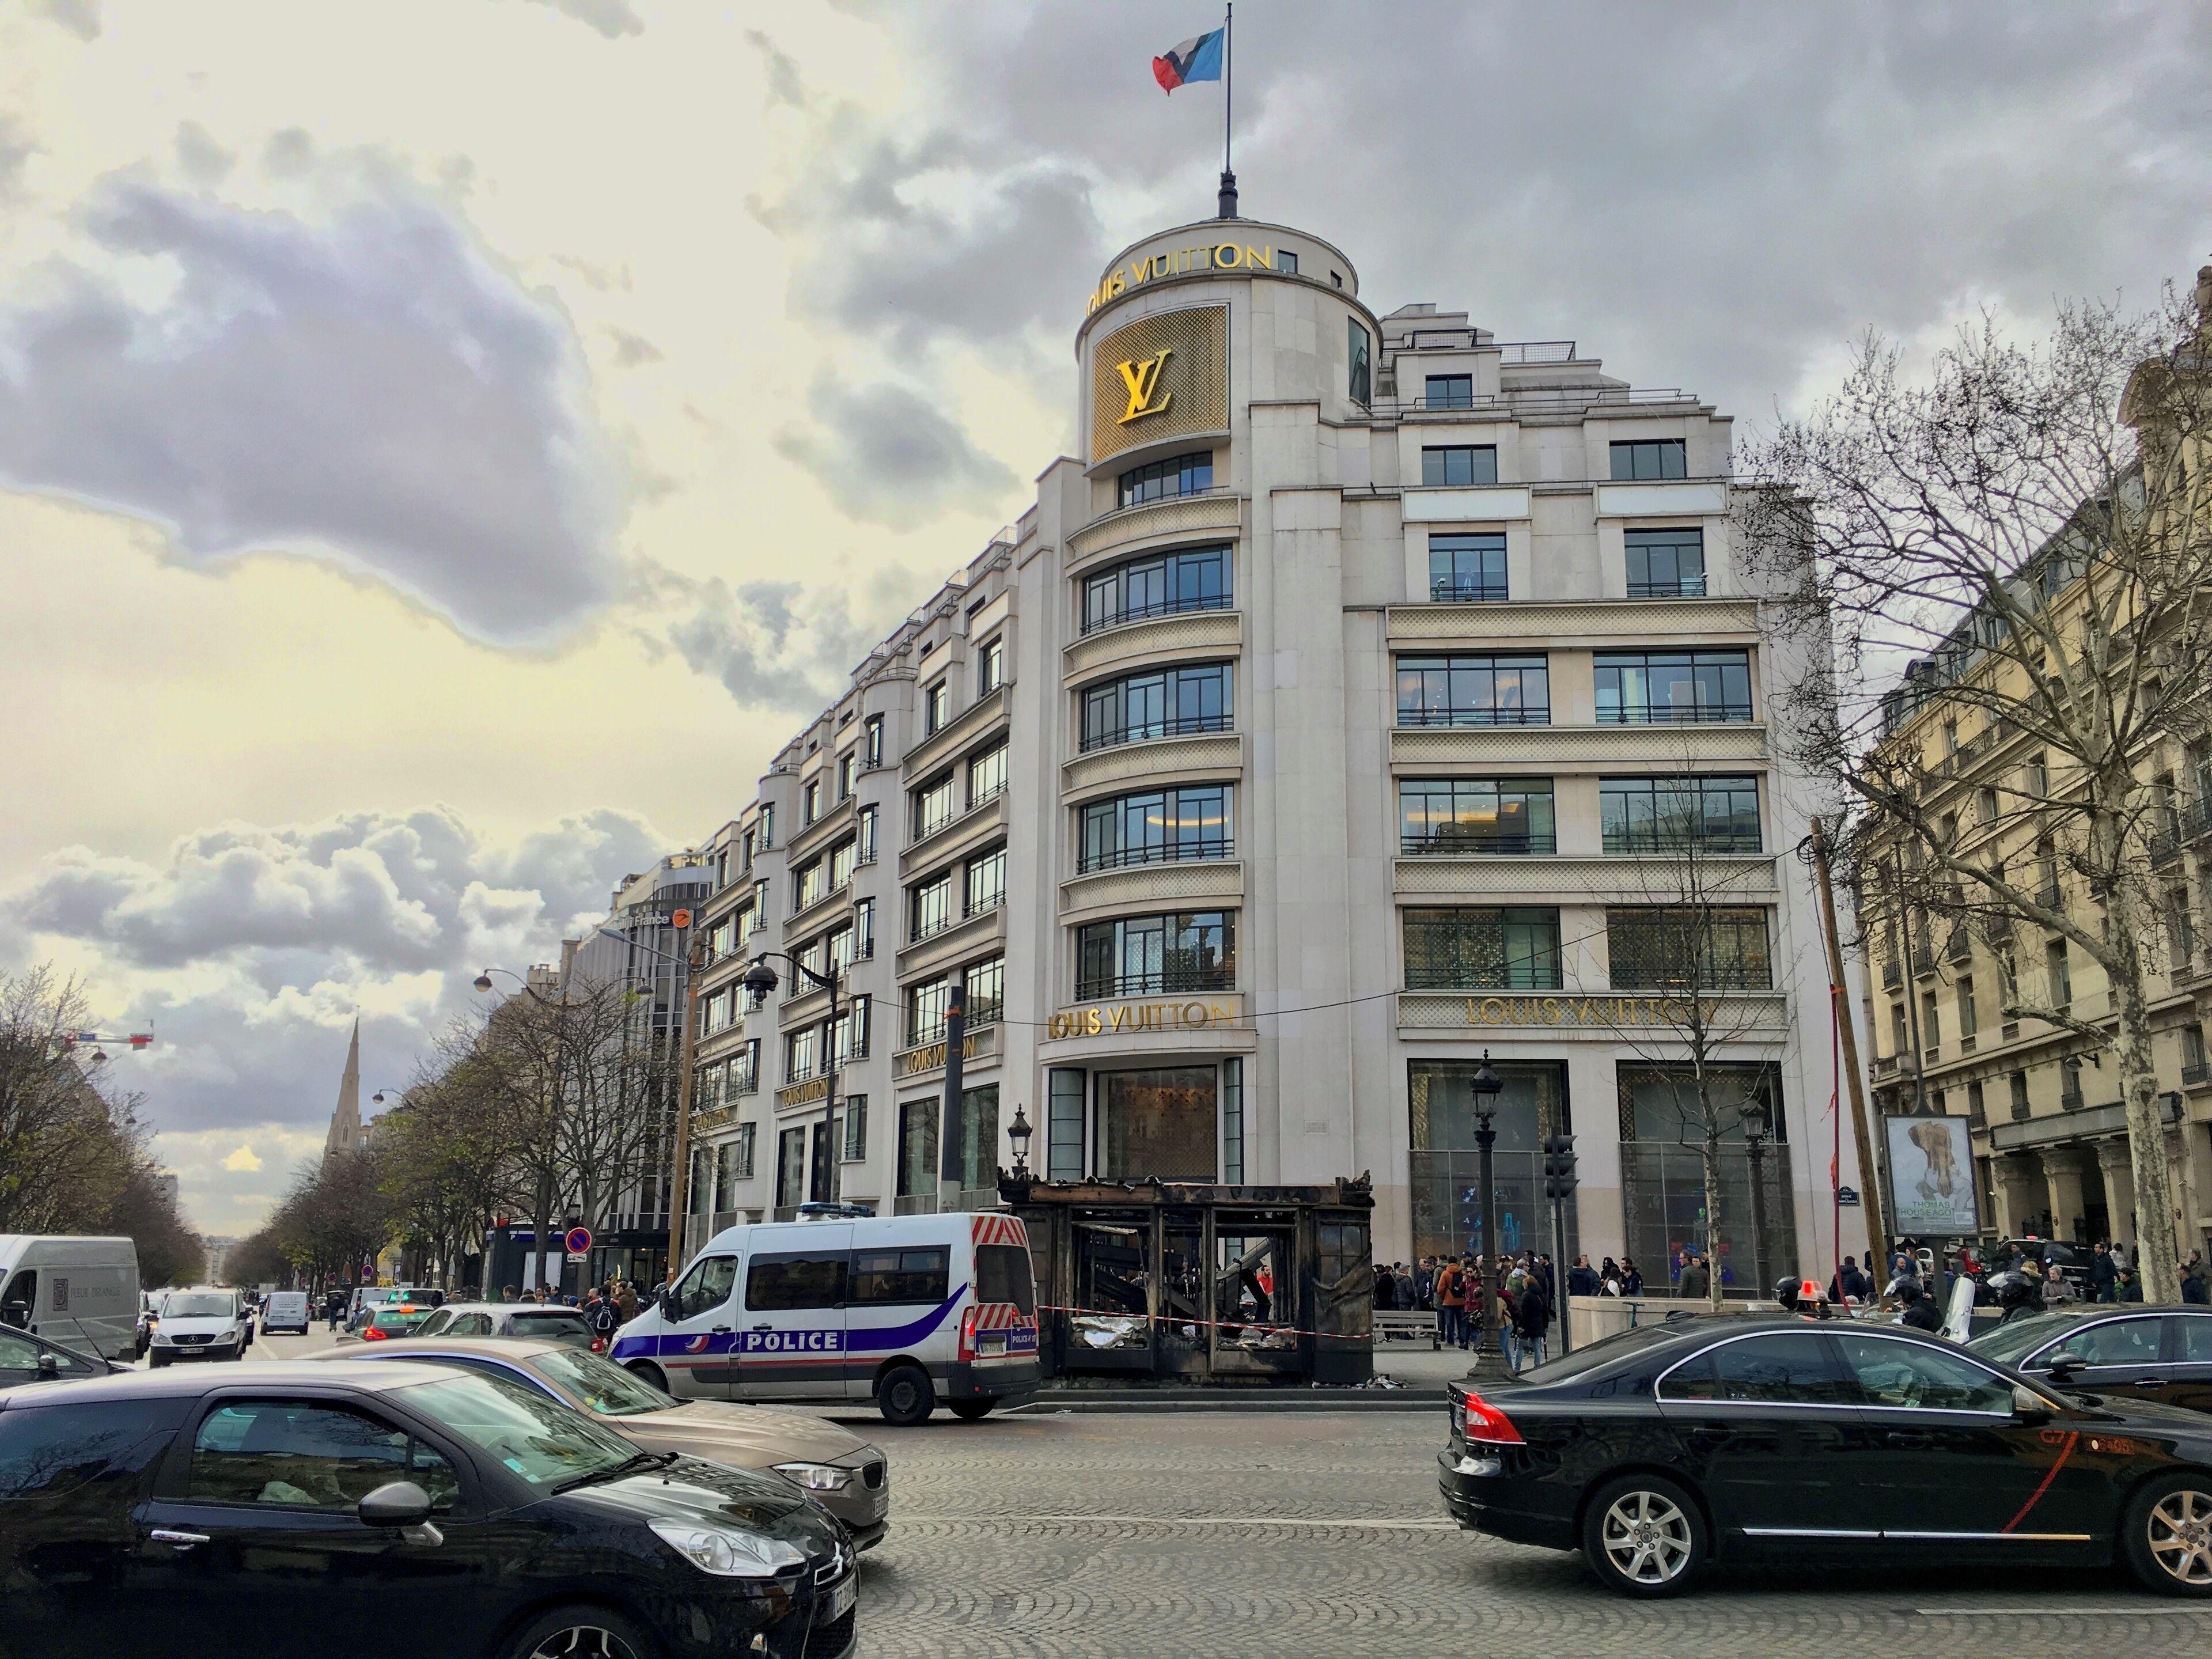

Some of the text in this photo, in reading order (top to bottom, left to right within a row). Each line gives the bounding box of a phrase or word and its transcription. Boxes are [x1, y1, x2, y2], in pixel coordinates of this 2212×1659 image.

[1131, 243, 1271, 283] VUITTON
[635, 915, 670, 926] France
[1048, 1001, 1233, 1039] LOUIS VUITTON
[1468, 998, 1561, 1024] LOUIS
[908, 1048, 933, 1073] LOUIS
[747, 1332, 838, 1350] POLICE
